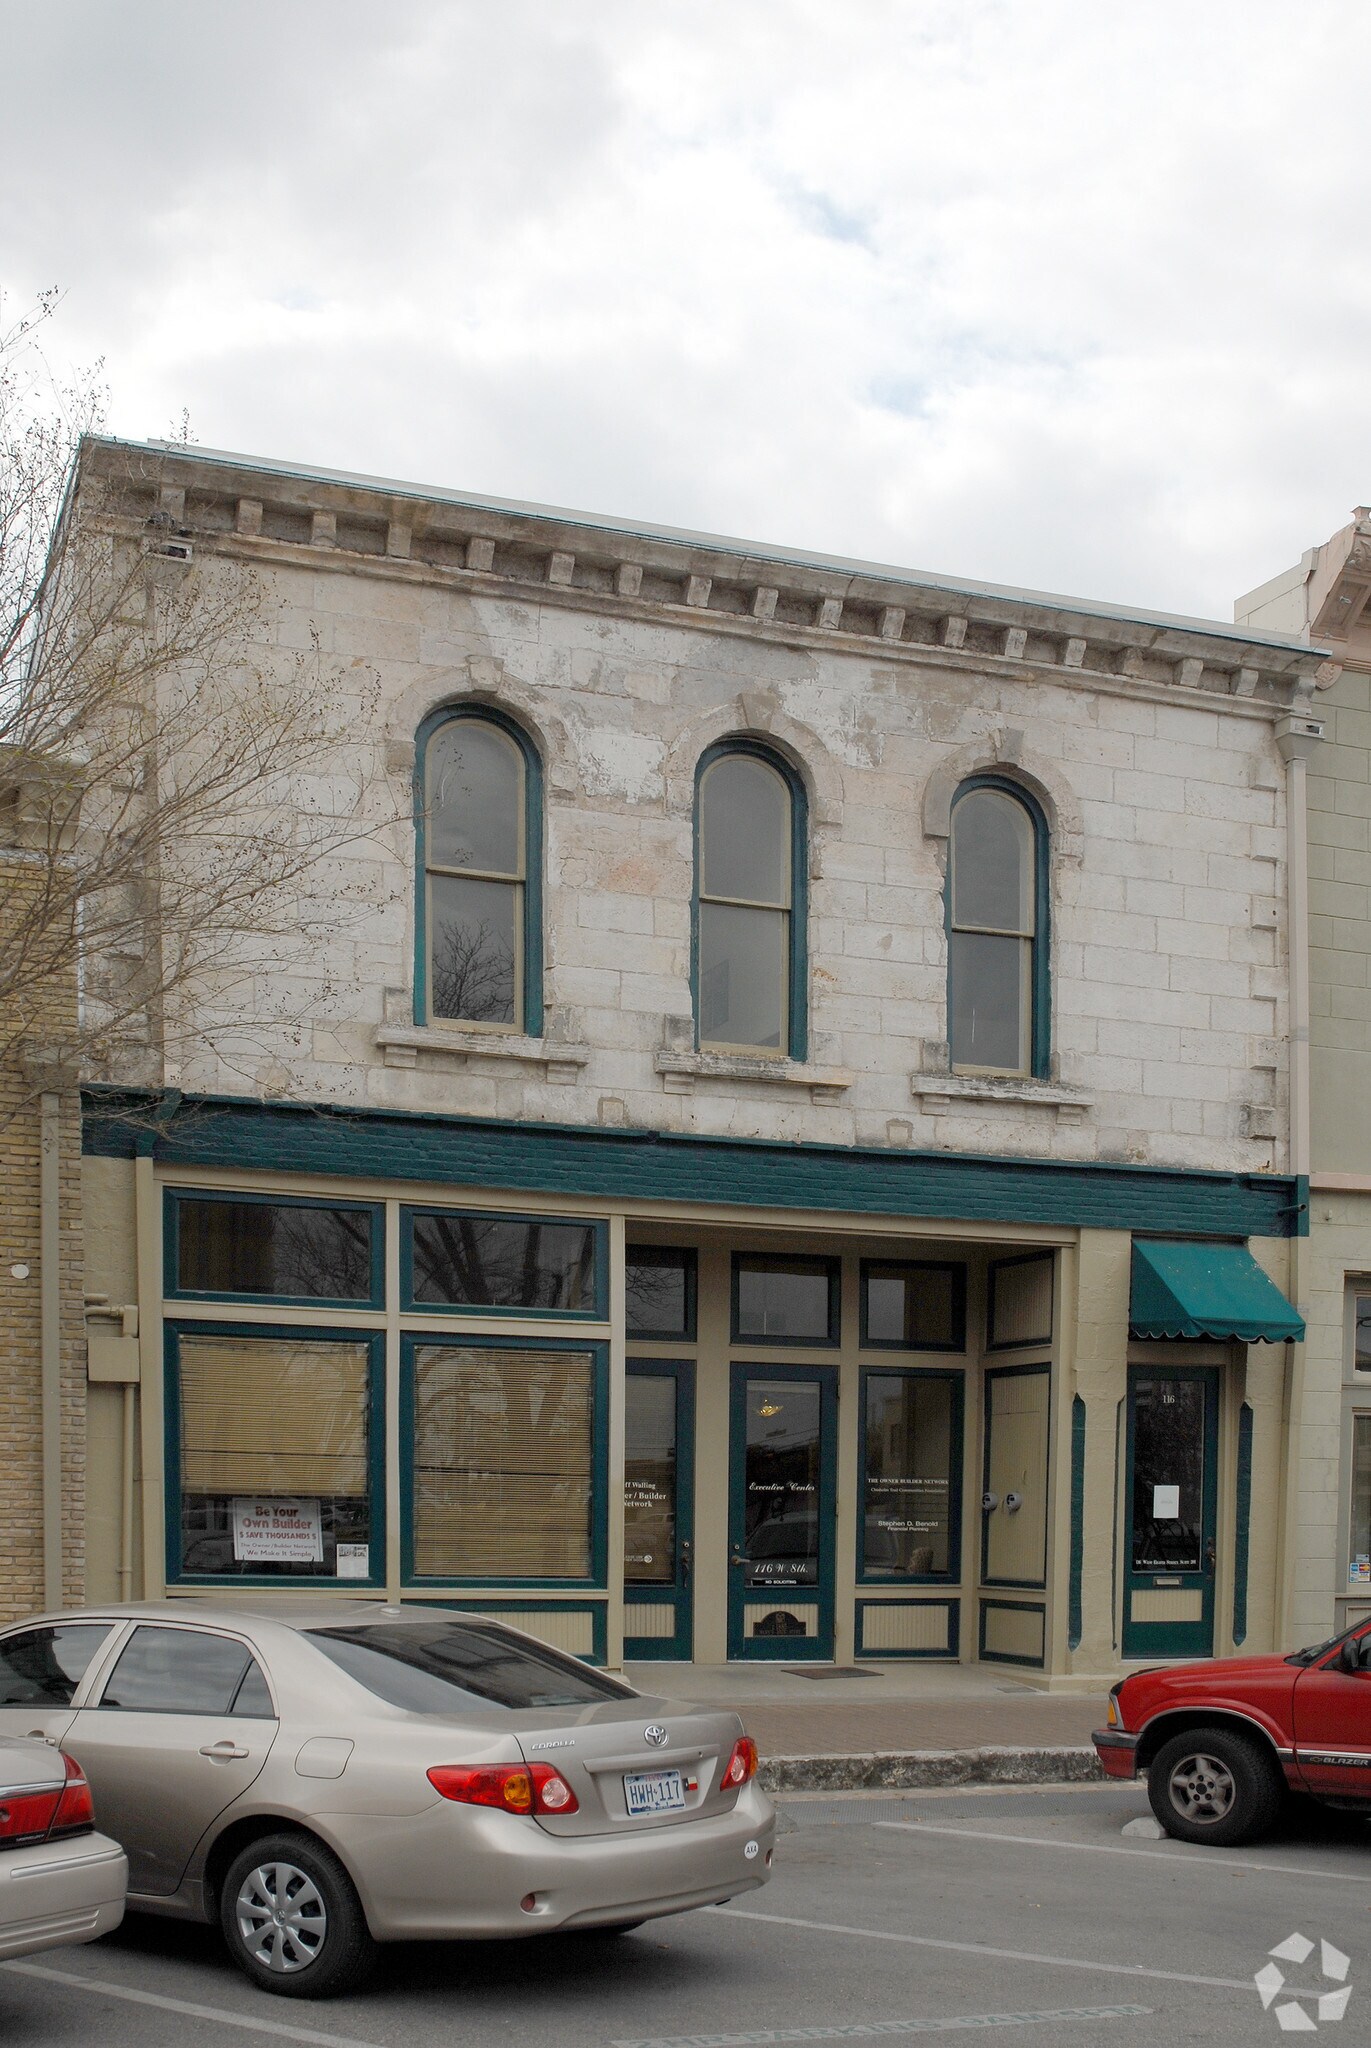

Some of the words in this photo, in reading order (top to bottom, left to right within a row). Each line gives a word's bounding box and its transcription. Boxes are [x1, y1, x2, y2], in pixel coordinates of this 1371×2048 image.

[1163, 1395, 1175, 1403] 116
[748, 1482, 784, 1491] Executive
[786, 1482, 815, 1491] Center
[639, 1492, 667, 1500] Builder
[255, 1506, 270, 1517] Be
[272, 1506, 299, 1518] Your
[242, 1518, 269, 1529] Own
[272, 1519, 313, 1530] Builder
[245, 1531, 264, 1539] SAVE
[265, 1532, 311, 1540] THOUSANDS
[289, 1550, 312, 1558] Simple
[754, 1563, 773, 1573] 116
[531, 1740, 575, 1750] COROLLA
[1323, 1757, 1369, 1765] BLAZER
[665, 2036, 732, 2047] HR
[743, 2020, 943, 2042] PARKING
